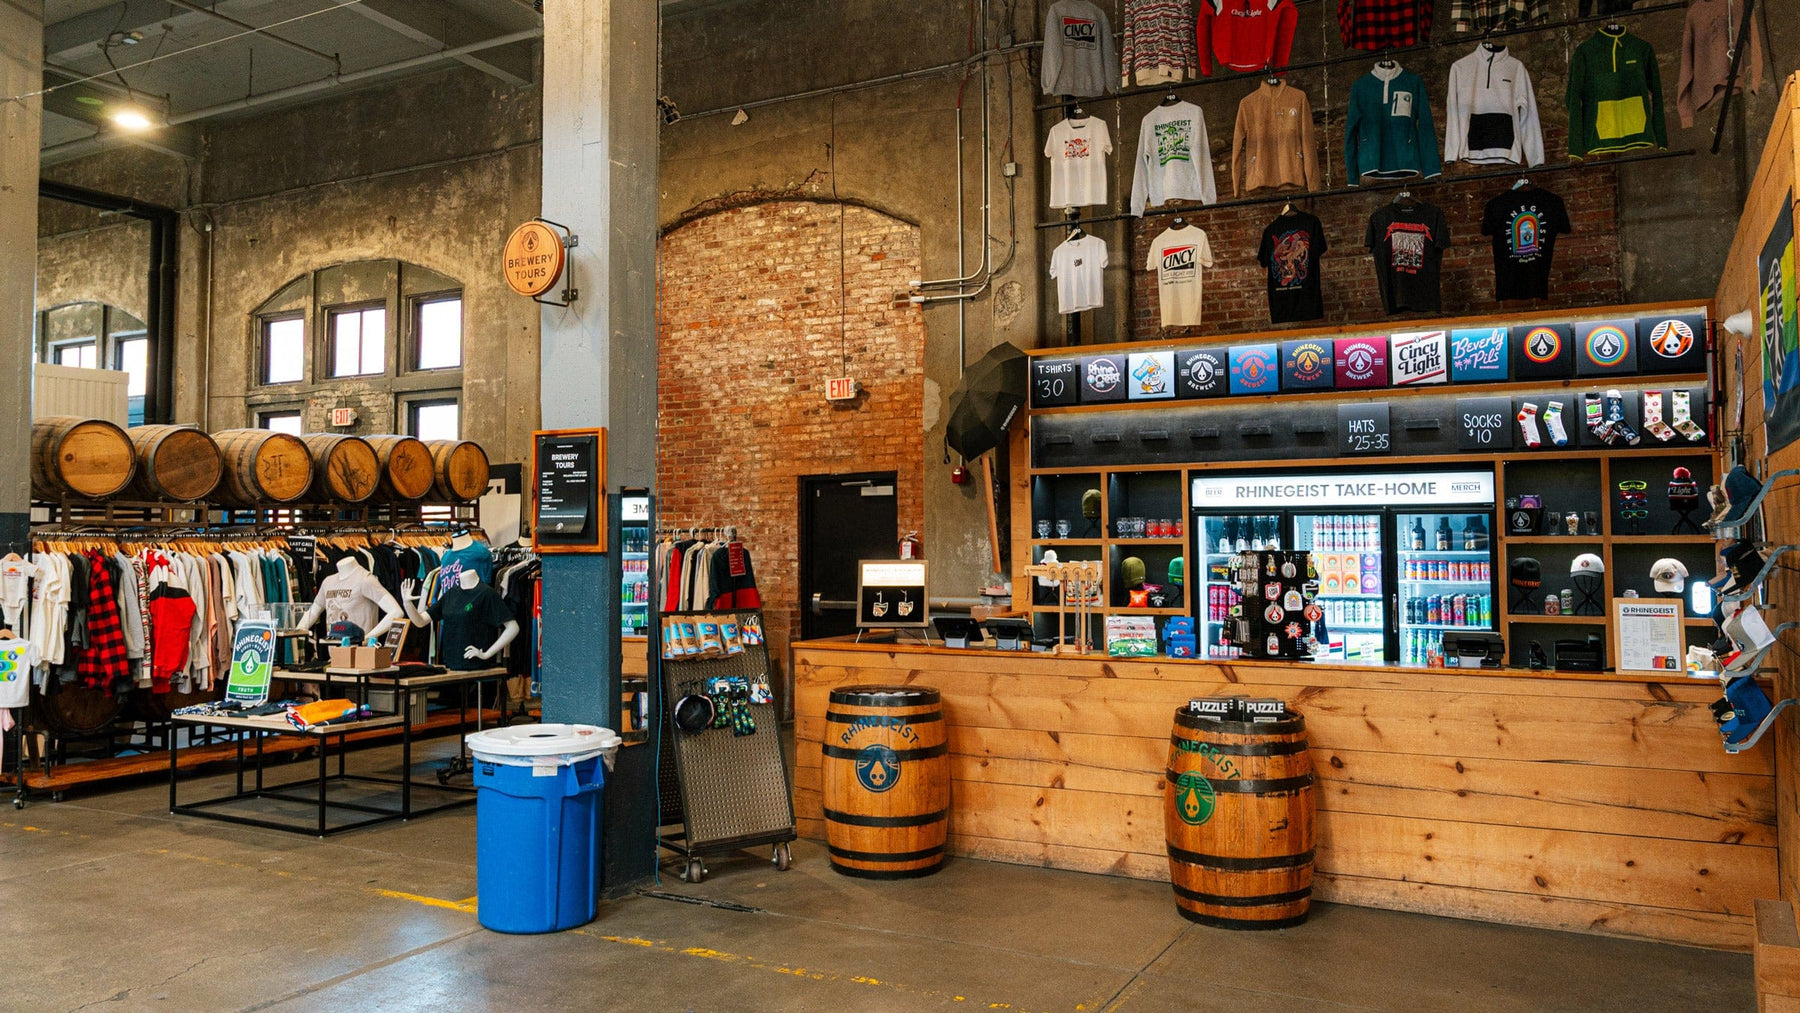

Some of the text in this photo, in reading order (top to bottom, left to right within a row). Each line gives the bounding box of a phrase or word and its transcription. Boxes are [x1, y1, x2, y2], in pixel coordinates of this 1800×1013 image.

[1064, 23, 1095, 37] CINCY
[1505, 205, 1547, 244] RHINEGEIST
[508, 253, 553, 269] BREWERY
[1163, 248, 1195, 270] CINCY
[515, 267, 546, 280] TOURS
[1292, 343, 1326, 357] RHINEGEIST
[1343, 342, 1378, 355] RHINEGEIST
[1398, 341, 1439, 361] Cincy
[1452, 328, 1504, 360] Beverly
[1186, 353, 1219, 367] RHINEGEIST
[1398, 354, 1441, 375] Light
[1470, 347, 1500, 369] Pils
[1038, 363, 1073, 375] T SHIRTS
[1087, 363, 1115, 375] Rhine
[1294, 369, 1323, 381] BREWERY
[1345, 369, 1375, 381] BREWERY
[830, 379, 850, 398] EXIT
[1037, 379, 1065, 399] $30
[1187, 380, 1217, 391] BREWERY
[1348, 419, 1375, 433] HATS
[1463, 413, 1502, 428] SOCKS
[1348, 433, 1389, 450] $25-35
[1469, 428, 1492, 443] $10
[551, 453, 579, 461] BREWERY
[555, 461, 575, 469] TOURS
[1235, 482, 1437, 498] RHINEGEIST TAKE-HOME
[1190, 701, 1228, 713] PUZZLE
[1246, 702, 1284, 714] PUZZLE
[841, 715, 919, 744] RHINEGEIST
